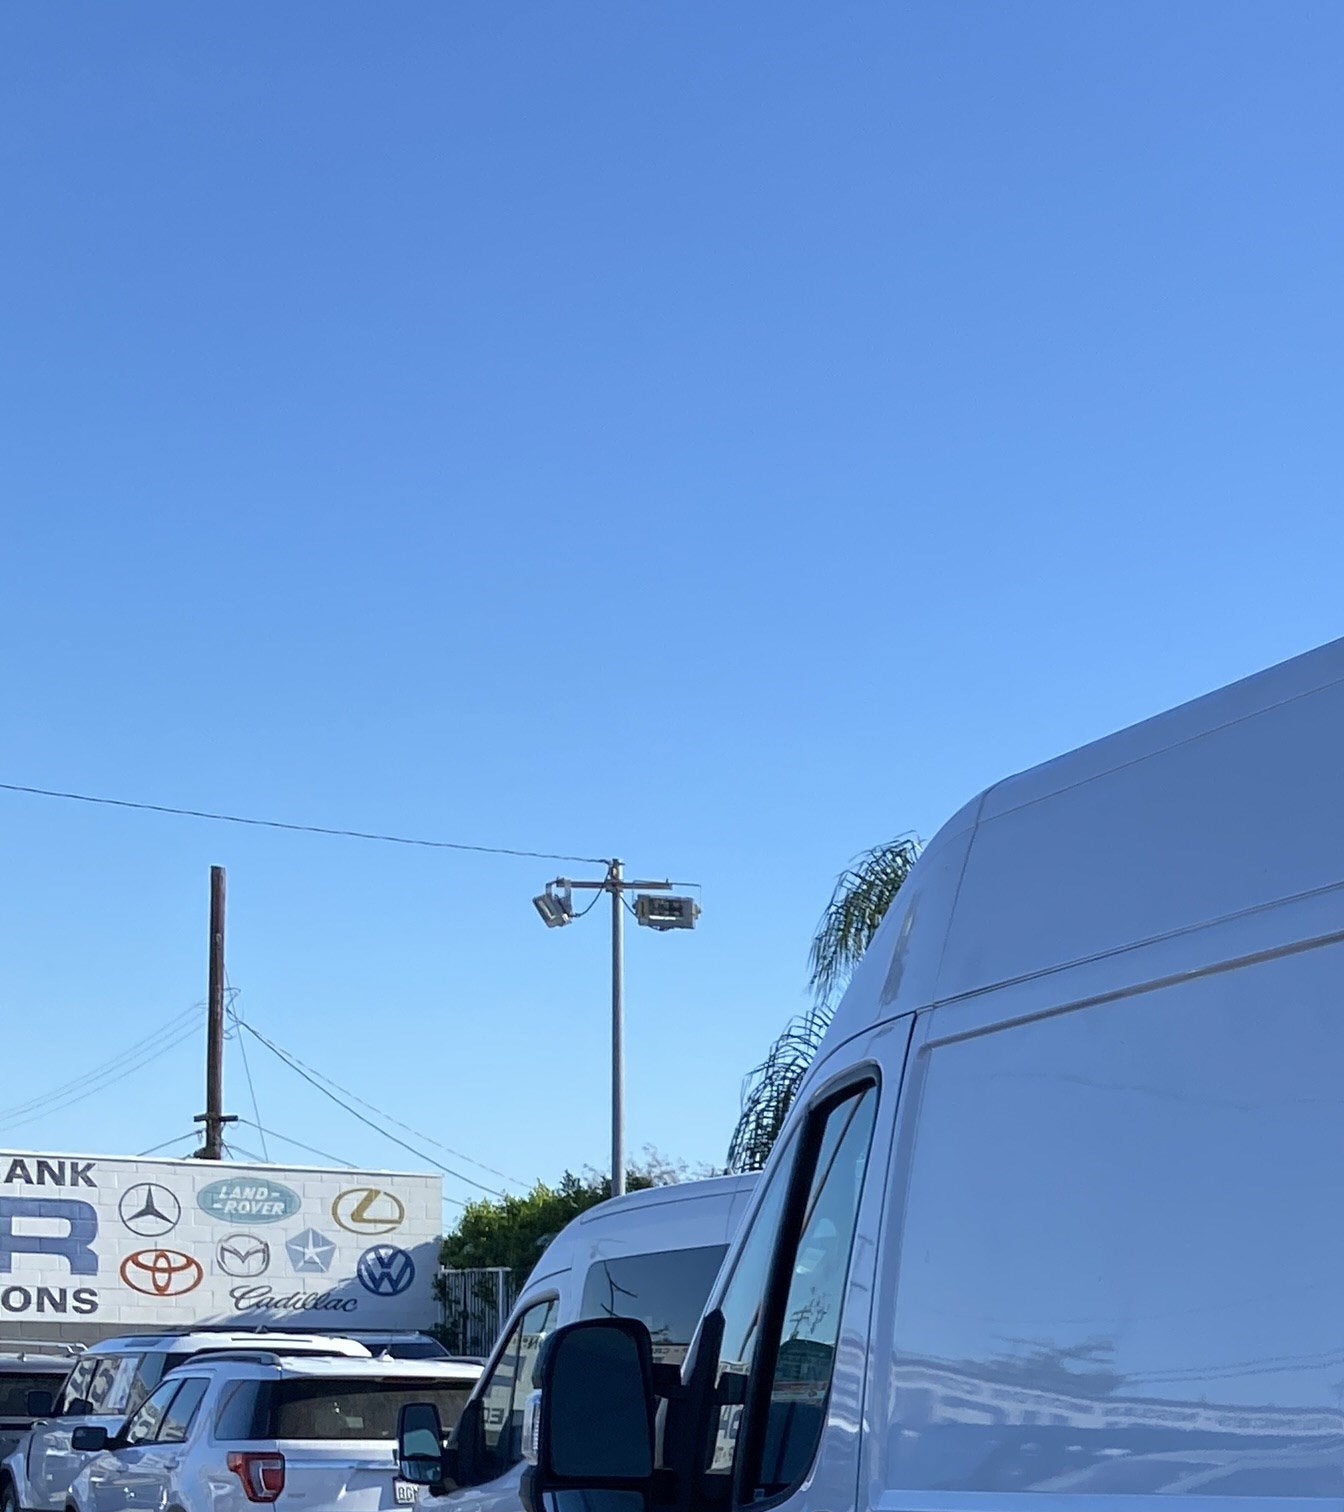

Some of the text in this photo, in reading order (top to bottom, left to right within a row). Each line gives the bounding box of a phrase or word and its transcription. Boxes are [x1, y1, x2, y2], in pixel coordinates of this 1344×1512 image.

[4, 1158, 98, 1188] ANK
[1, 1286, 99, 1314] ONS
[229, 1285, 358, 1312] Cadillac
